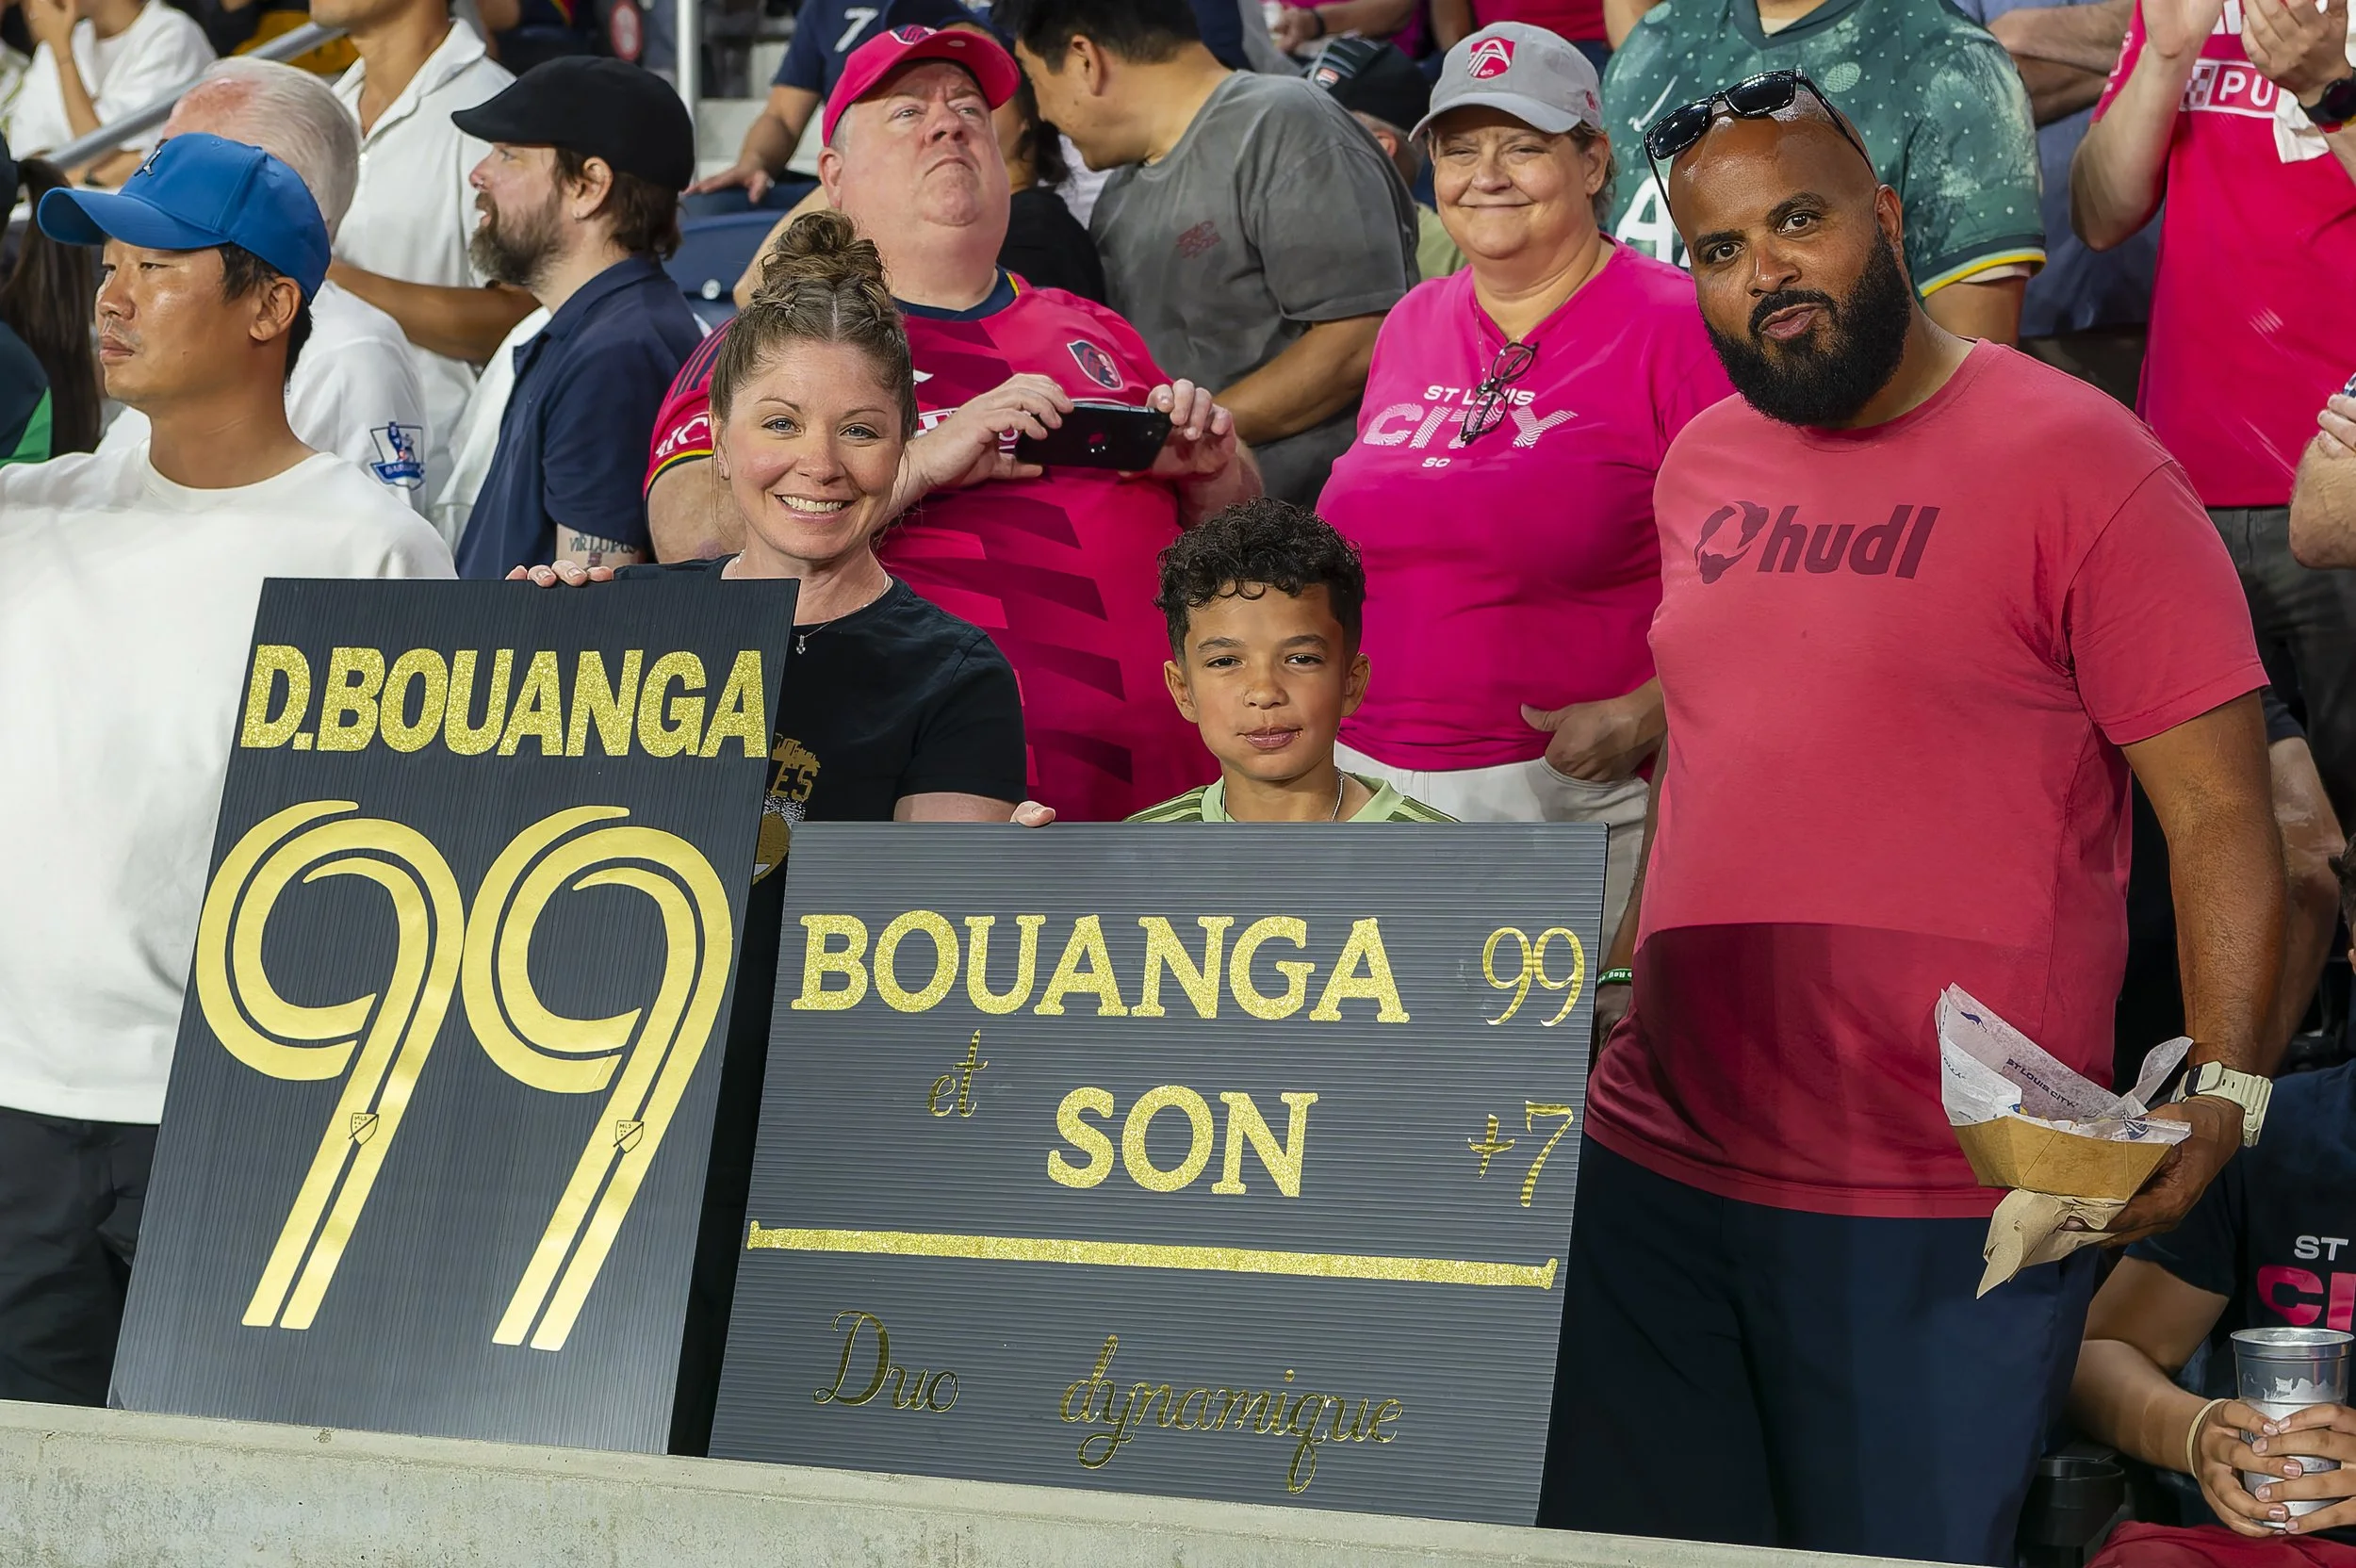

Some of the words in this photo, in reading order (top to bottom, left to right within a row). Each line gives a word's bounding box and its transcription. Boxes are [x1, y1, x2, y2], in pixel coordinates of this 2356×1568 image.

[833, 7, 879, 53] 7
[1363, 402, 1579, 449] CITY
[1423, 384, 1461, 403] ST
[1421, 456, 1452, 468] SC
[1756, 504, 1941, 580] hudl
[239, 644, 769, 759] D.BOUANGA
[791, 909, 1411, 1024] BOUANGA
[1481, 926, 1585, 1027] 99
[195, 799, 734, 1351] 99
[927, 1029, 989, 1119] et
[2020, 1068, 2050, 1094] LOUIS
[2051, 1090, 2079, 1108] CITY
[1047, 1085, 1319, 1198] SON
[2293, 1233, 2349, 1262] ST
[812, 1309, 960, 1413] Duo
[1058, 1333, 1405, 1495] dynamique
